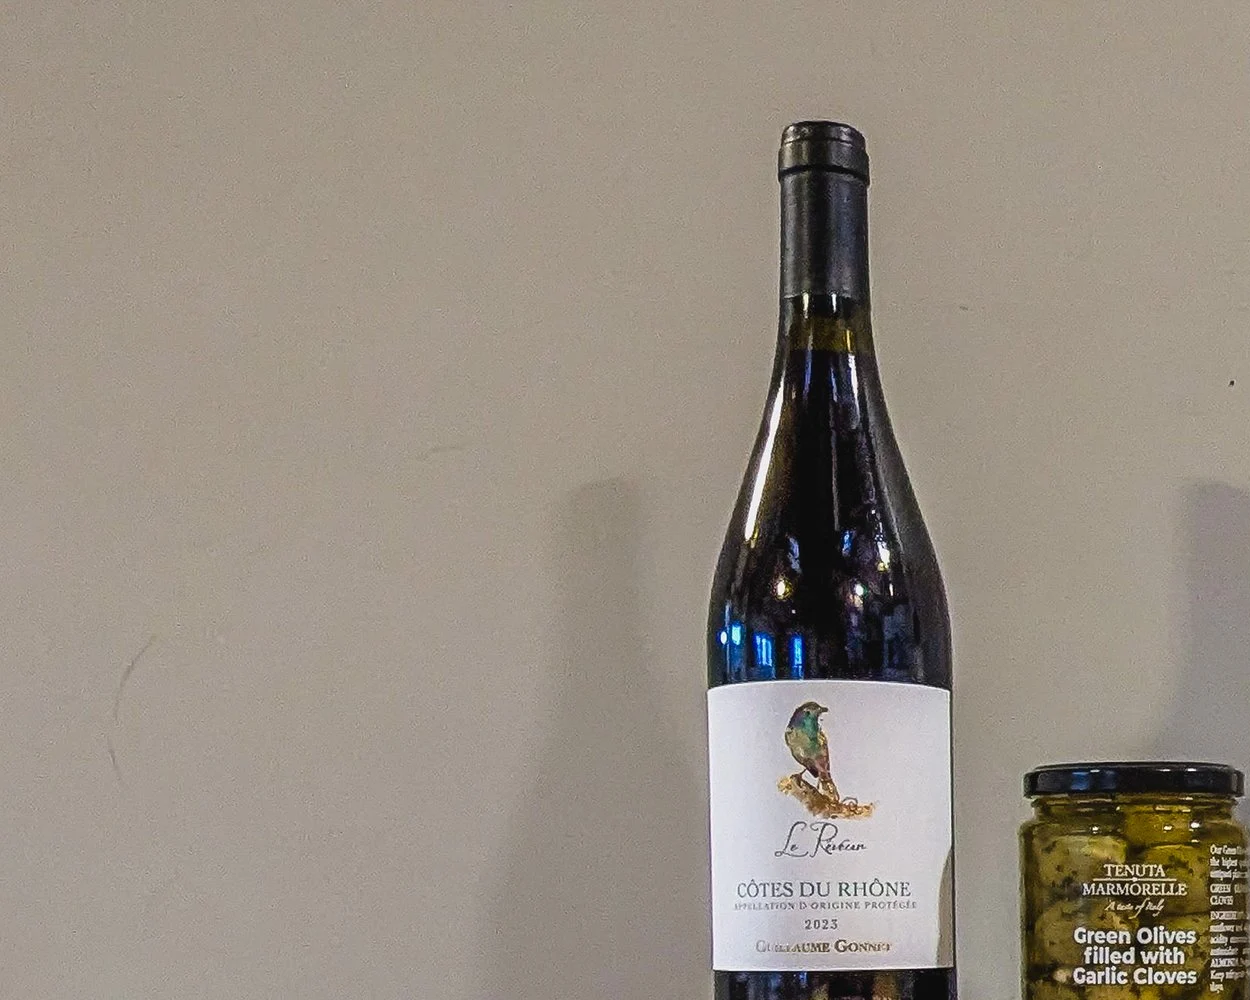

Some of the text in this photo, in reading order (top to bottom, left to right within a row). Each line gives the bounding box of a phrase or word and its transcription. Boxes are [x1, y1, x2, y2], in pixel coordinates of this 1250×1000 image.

[1103, 864, 1166, 877] TENUTA
[737, 878, 912, 898] CÔTES DU RHÔNE
[1082, 883, 1188, 896] MARMORELLE
[804, 918, 838, 930] 2023
[1074, 925, 1197, 944] Green Olives
[1084, 946, 1185, 964] filled with
[1073, 966, 1197, 985] Garlic Cloves
